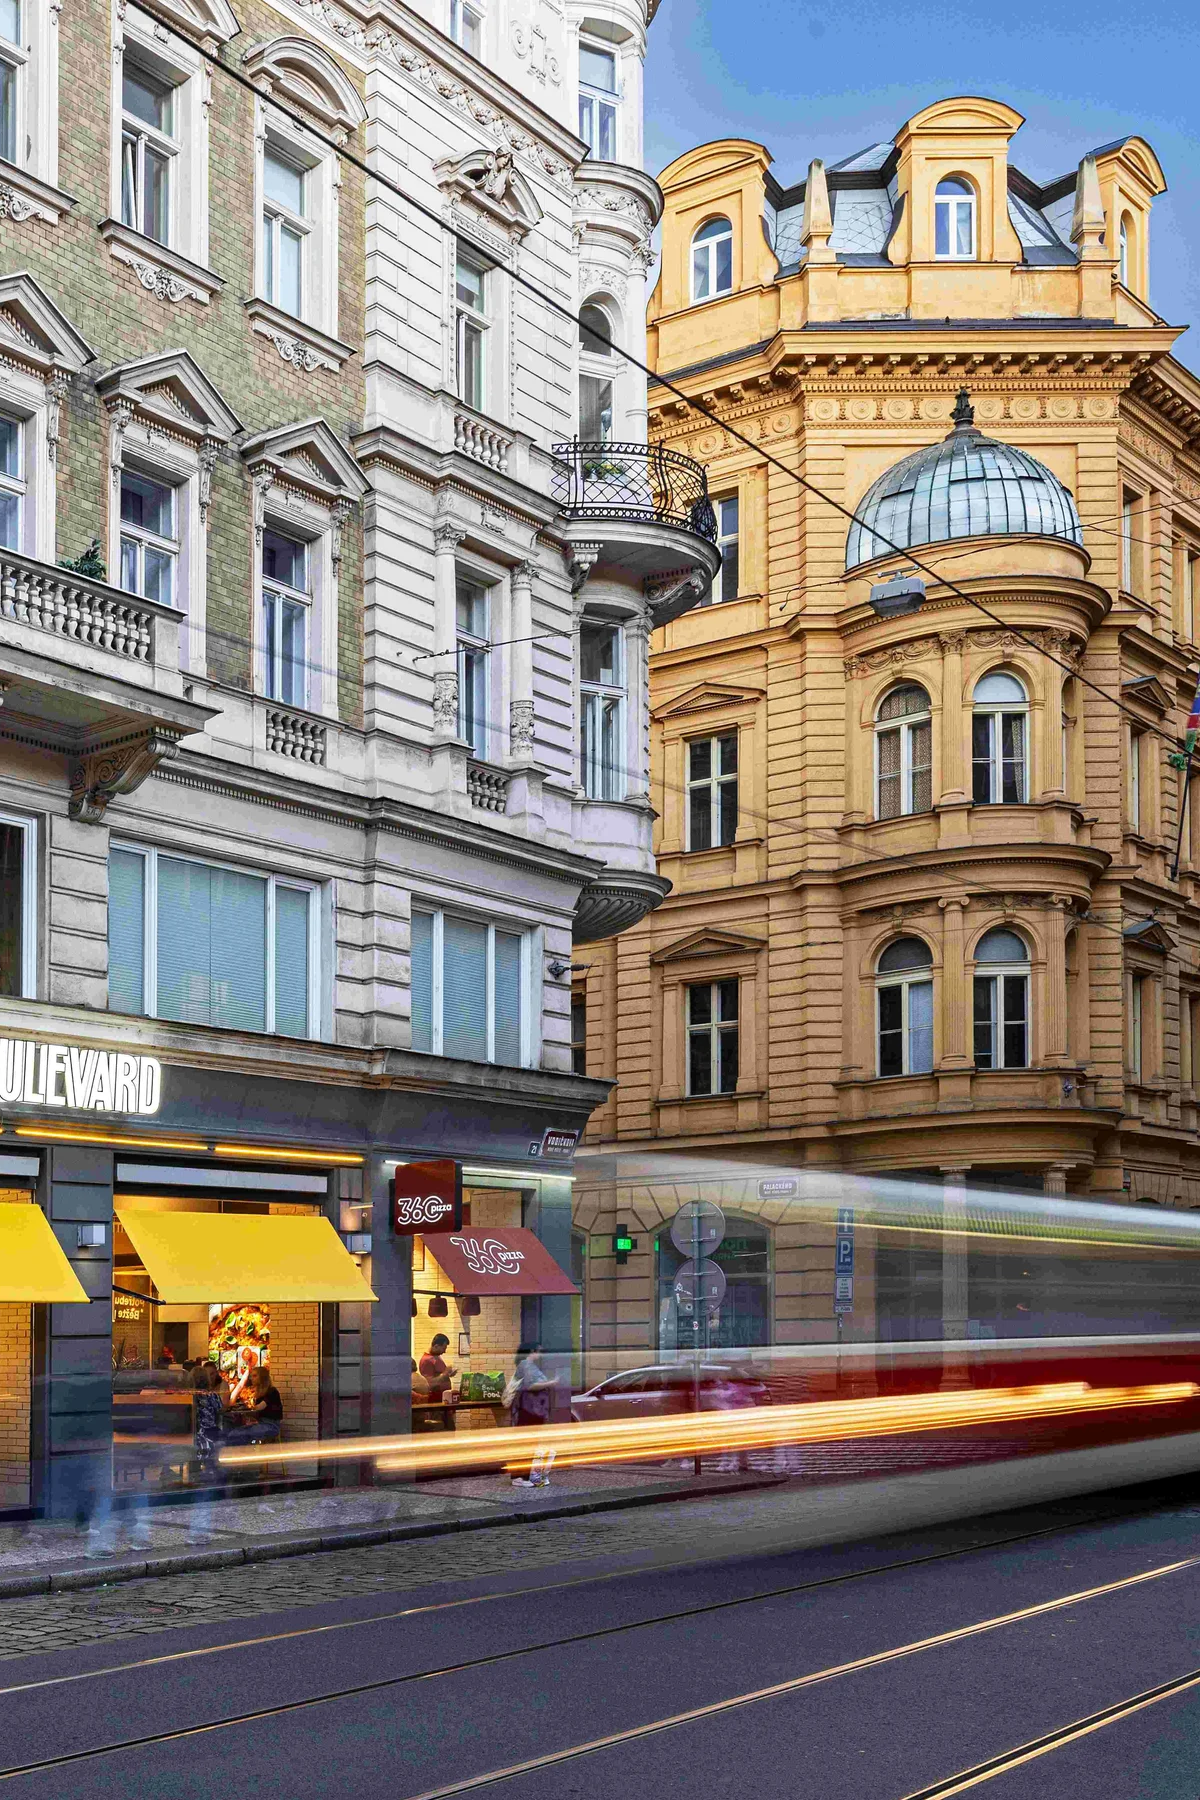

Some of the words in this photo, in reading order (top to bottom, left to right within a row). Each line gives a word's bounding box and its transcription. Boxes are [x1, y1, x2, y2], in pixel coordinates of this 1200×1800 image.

[431, 1203, 452, 1214] pizza
[497, 1251, 525, 1263] pizza
[840, 1240, 851, 1263] P
